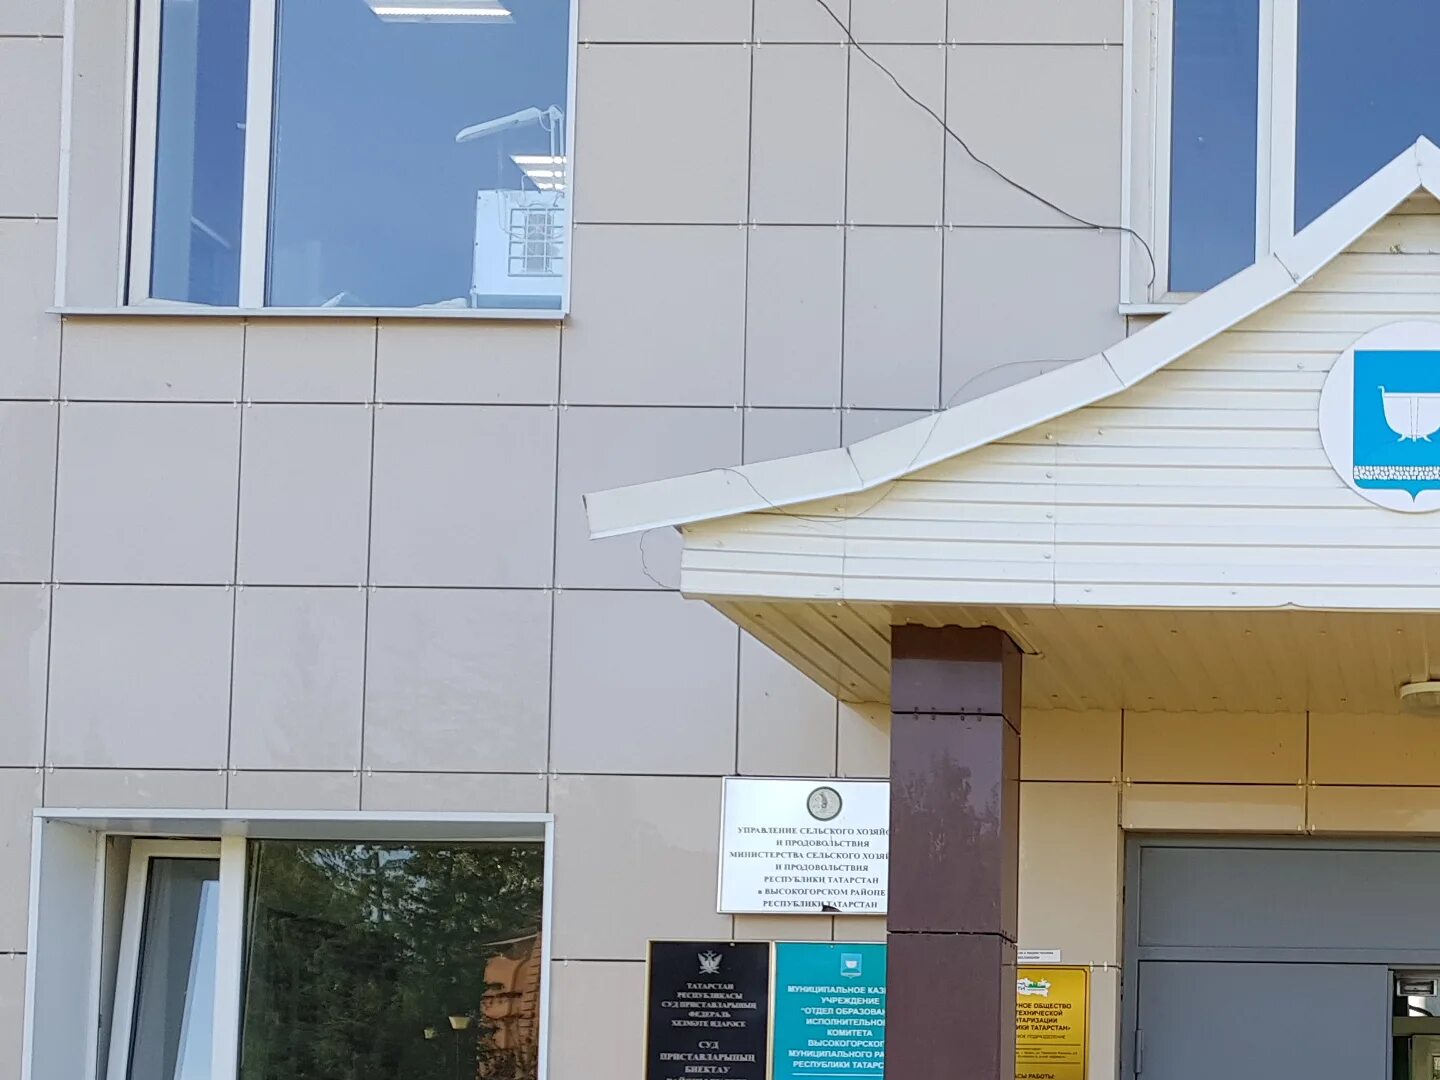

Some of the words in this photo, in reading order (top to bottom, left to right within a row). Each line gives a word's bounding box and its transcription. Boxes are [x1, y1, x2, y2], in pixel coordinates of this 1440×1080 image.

[851, 888, 885, 896] РАЙОНЕ
[821, 997, 880, 1005] УЧРЕЖДЕНИЕ
[806, 1018, 885, 1026] ИСПОЛНИТЕЛЬНО
[660, 1053, 756, 1062] ПРИСТАВЛАРЫНЫҢ
[789, 1050, 872, 1058] МУНИЦИПАЛЬНОГО
